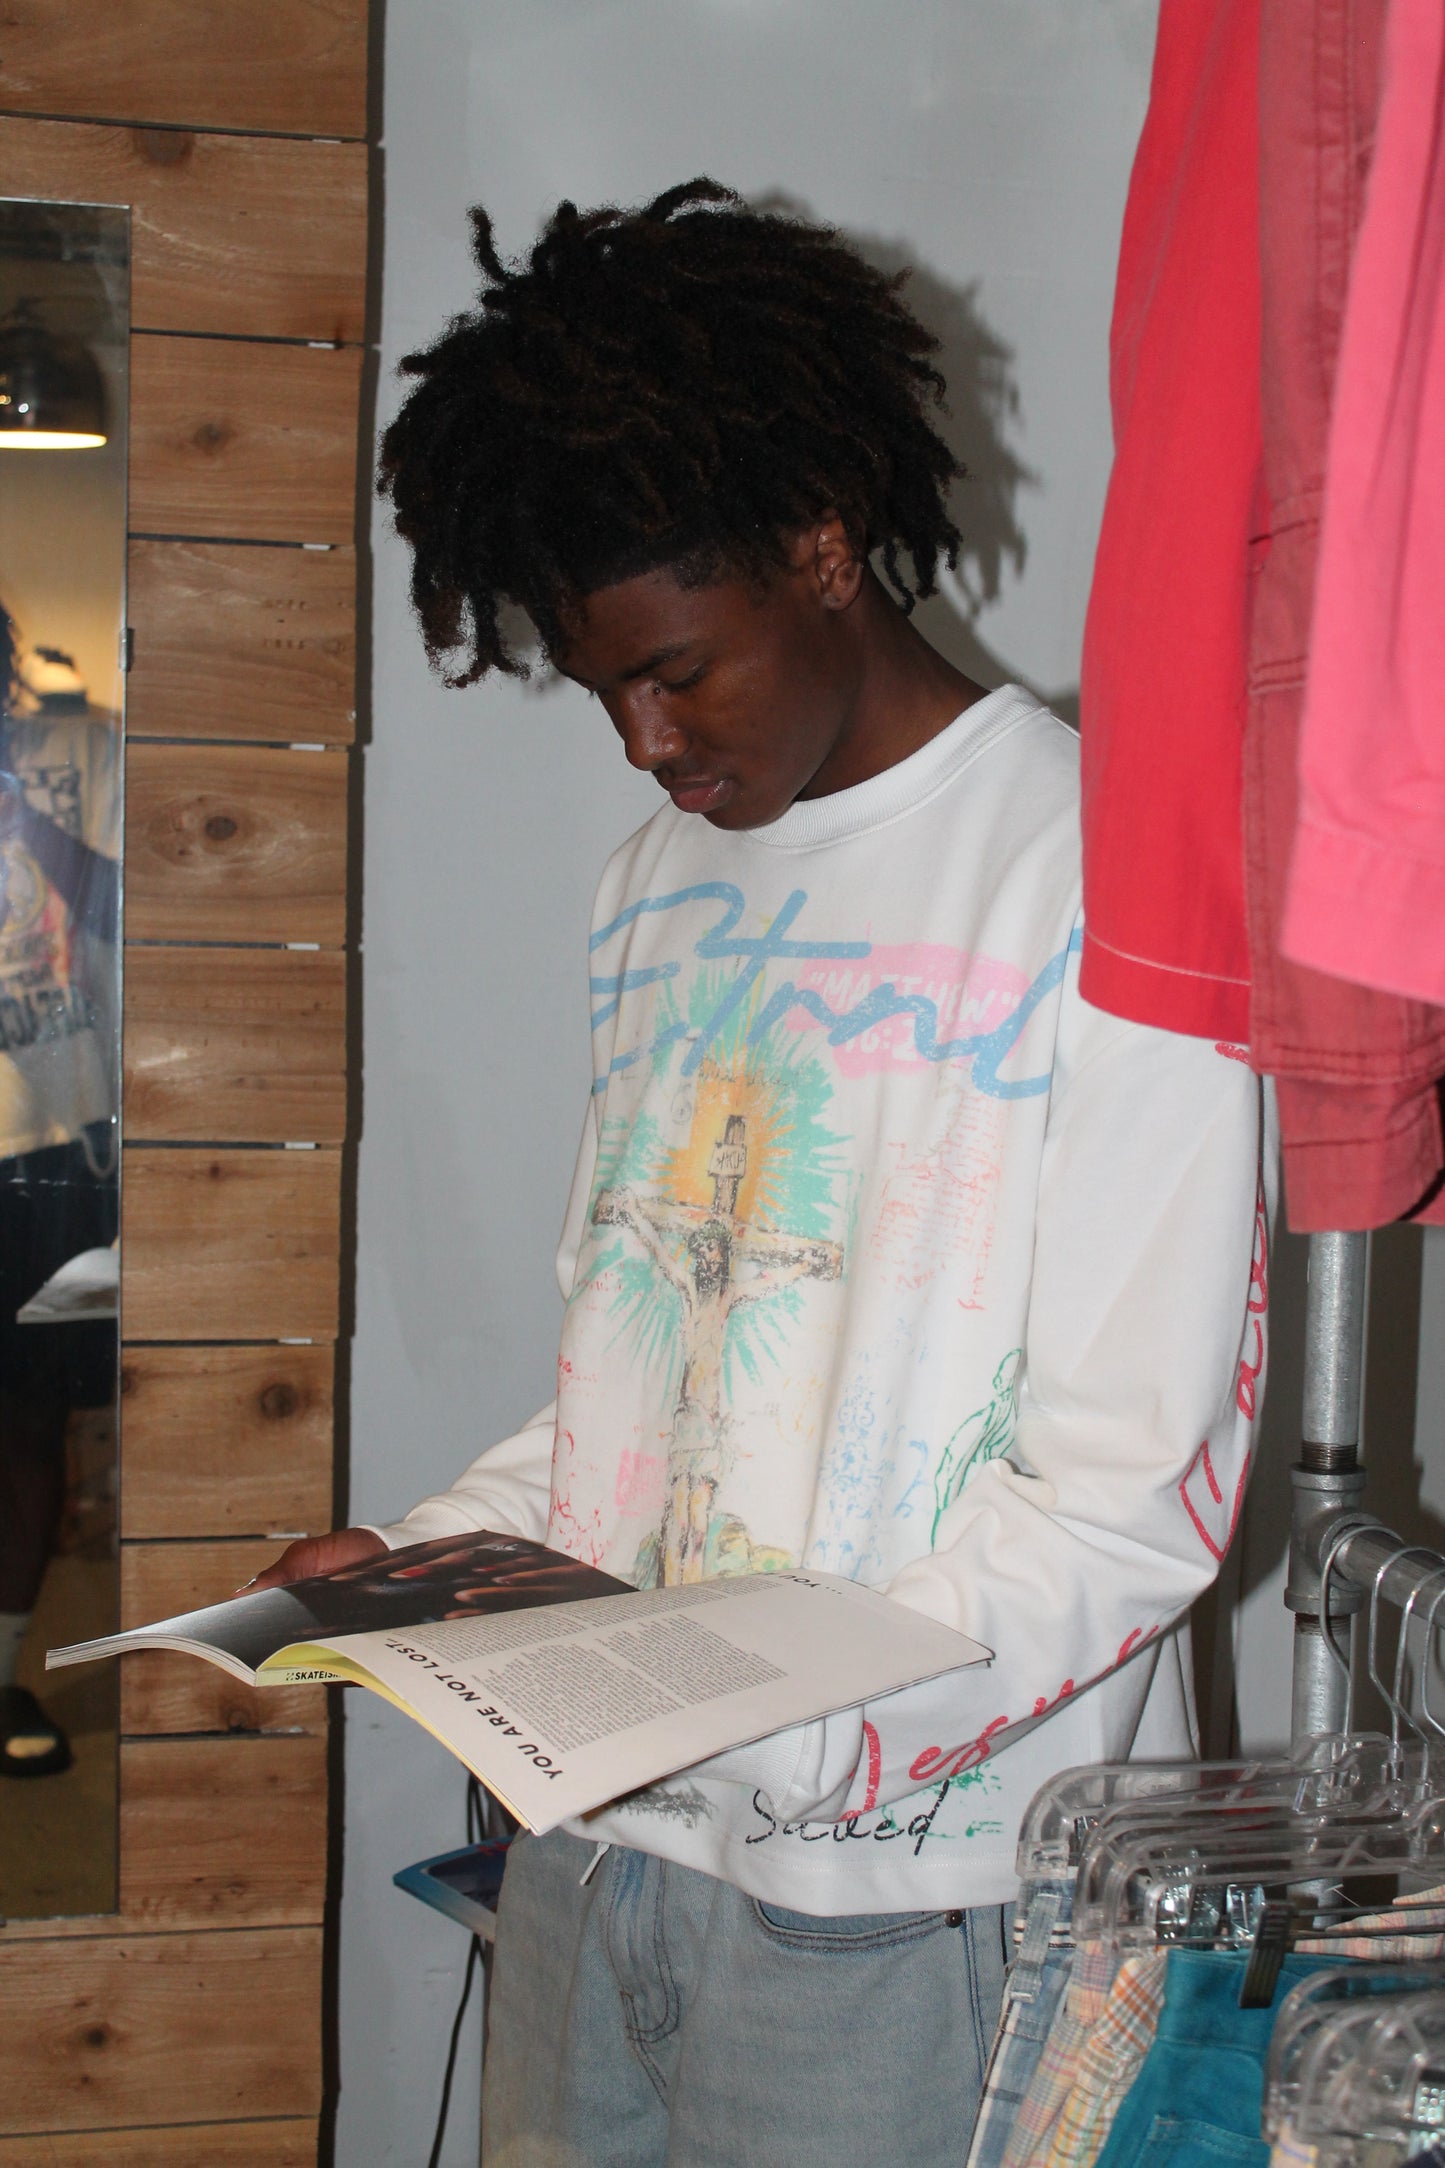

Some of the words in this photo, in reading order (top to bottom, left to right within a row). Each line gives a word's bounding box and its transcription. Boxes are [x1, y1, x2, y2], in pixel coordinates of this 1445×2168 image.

[434, 1673, 481, 1702] NOT
[476, 1706, 523, 1736] ARE
[517, 1743, 564, 1779] YOU
